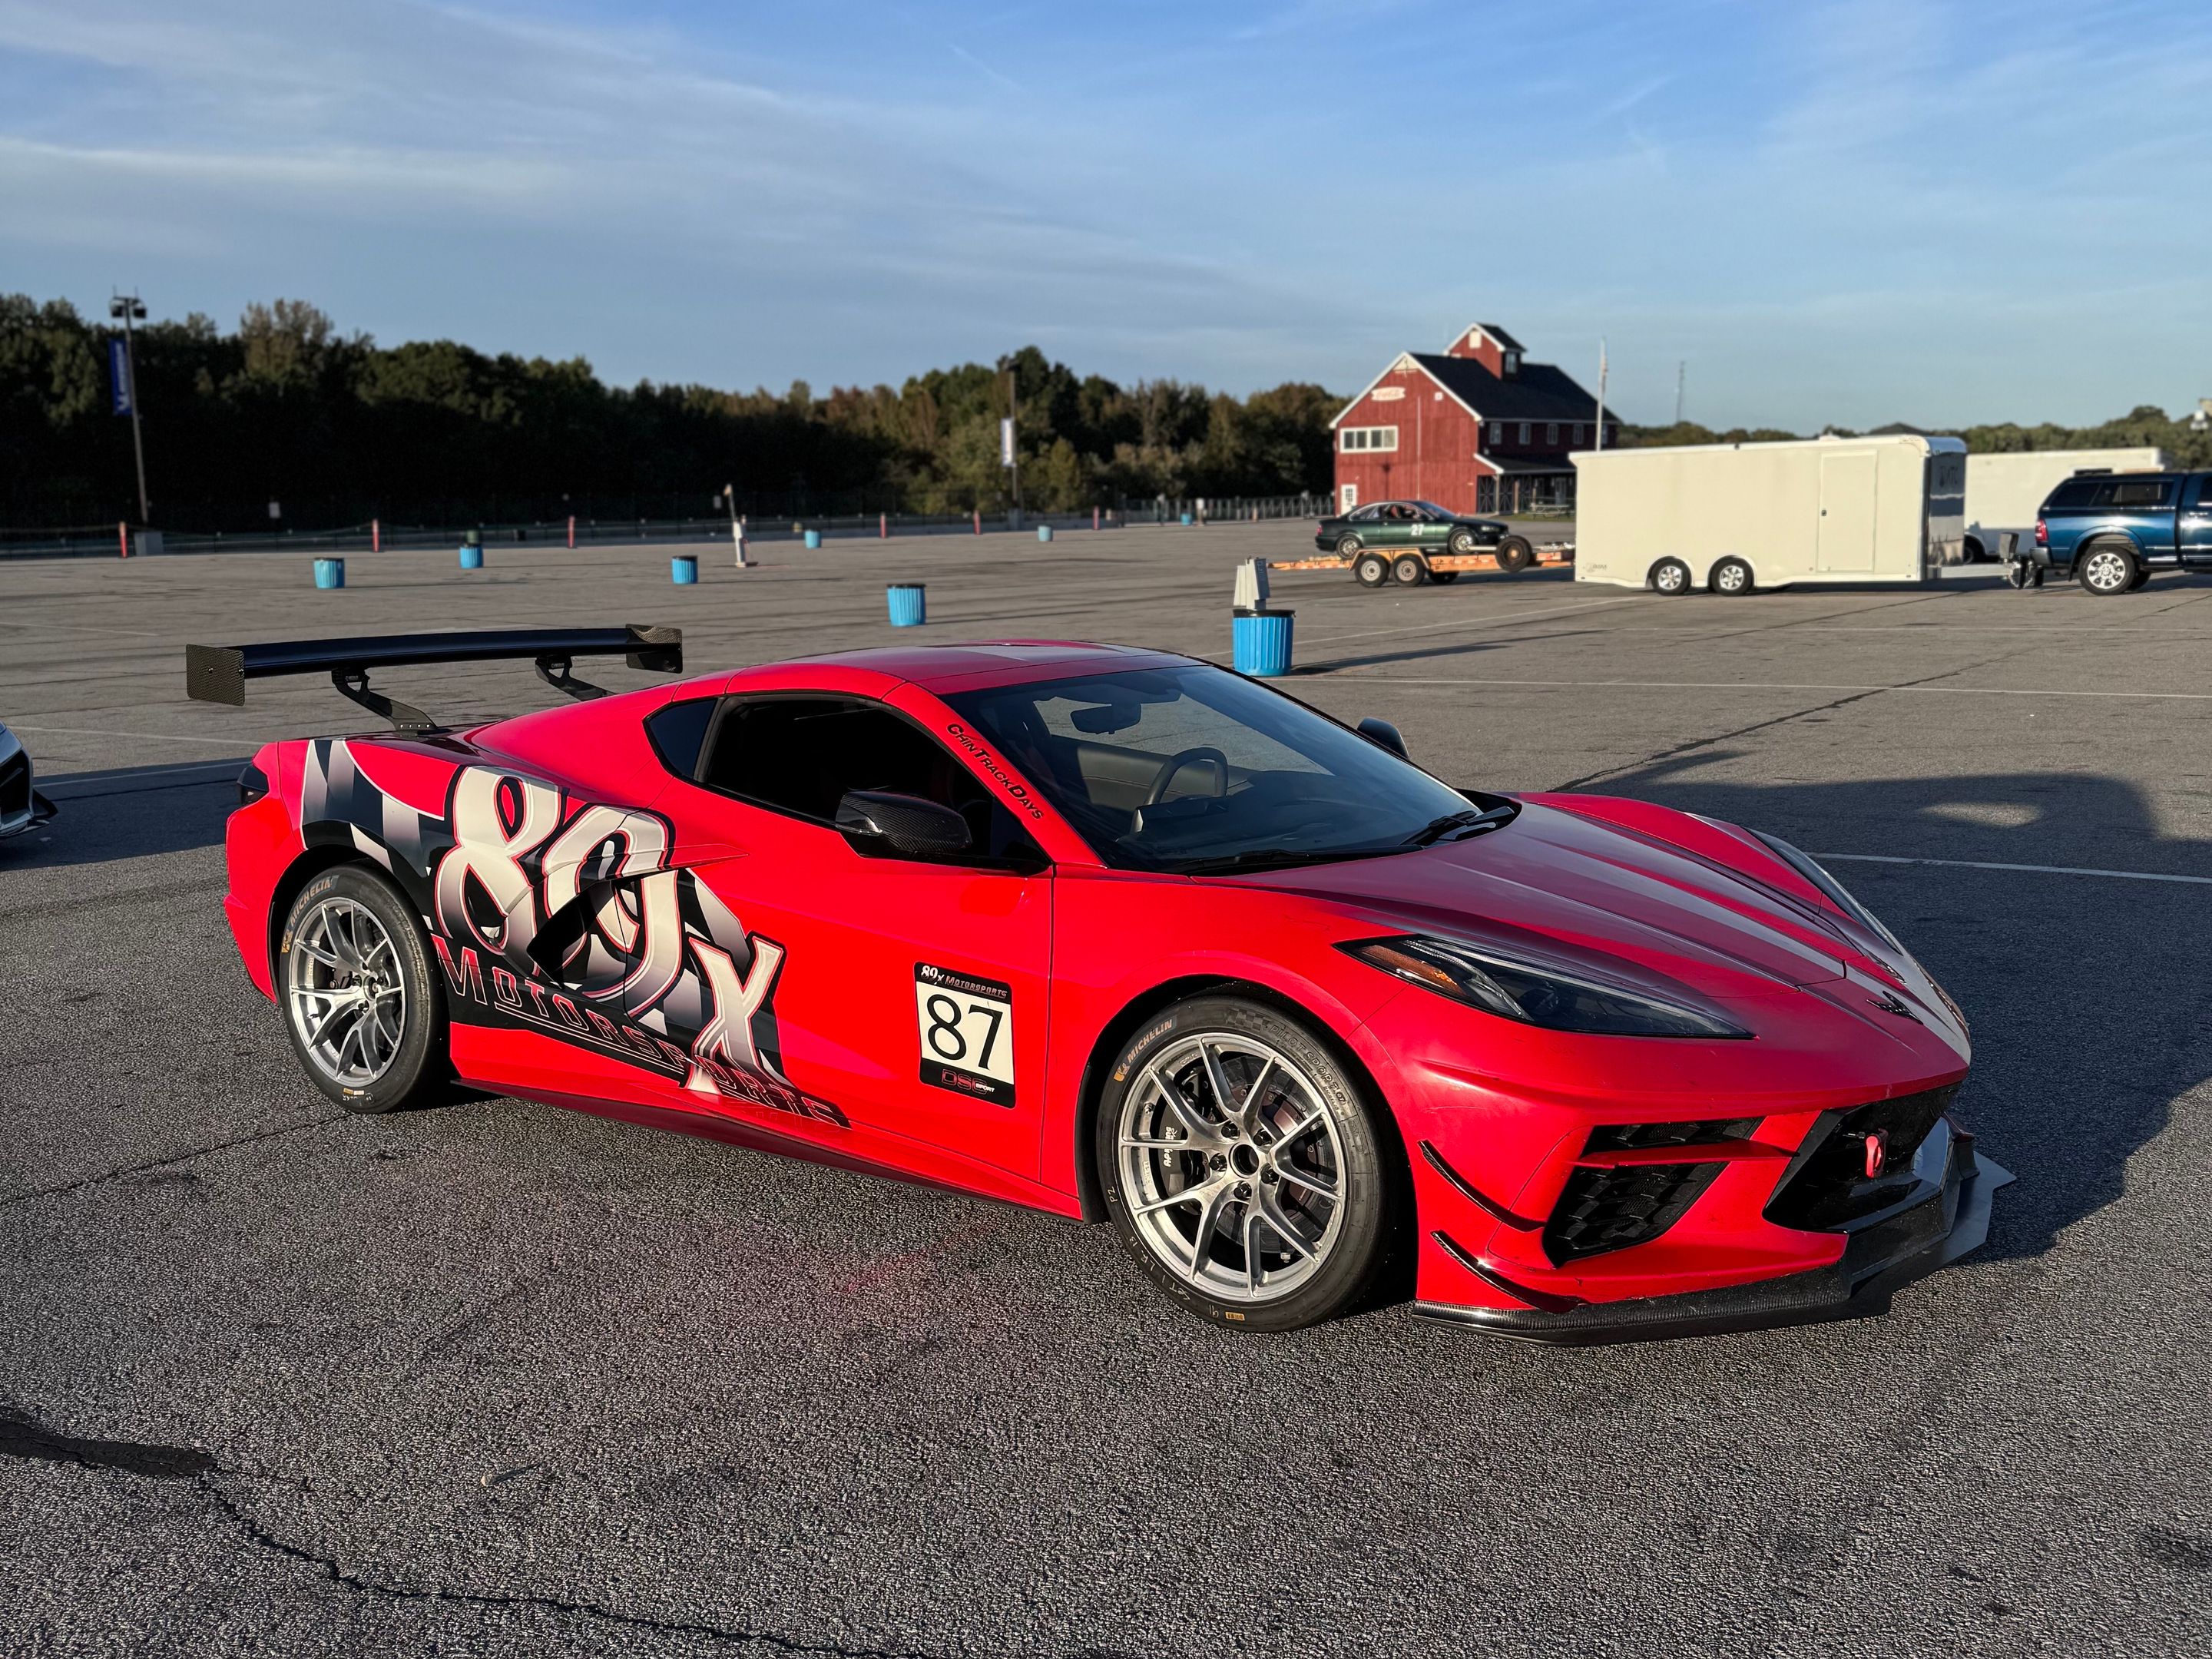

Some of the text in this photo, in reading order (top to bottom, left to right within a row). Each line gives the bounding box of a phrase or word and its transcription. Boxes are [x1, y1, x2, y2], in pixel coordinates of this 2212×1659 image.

[1410, 523, 1425, 536] 27
[290, 878, 333, 928] MICHELIN
[945, 975, 1008, 997] MOTORSPORTS
[431, 933, 841, 1127] MOTORSPORTS
[927, 994, 1004, 1071] 87
[1127, 1018, 1172, 1065] MICHELIN
[942, 1068, 988, 1095] DSC
[1270, 1025, 1306, 1052] PILOT
[1306, 1051, 1339, 1093] SPORT
